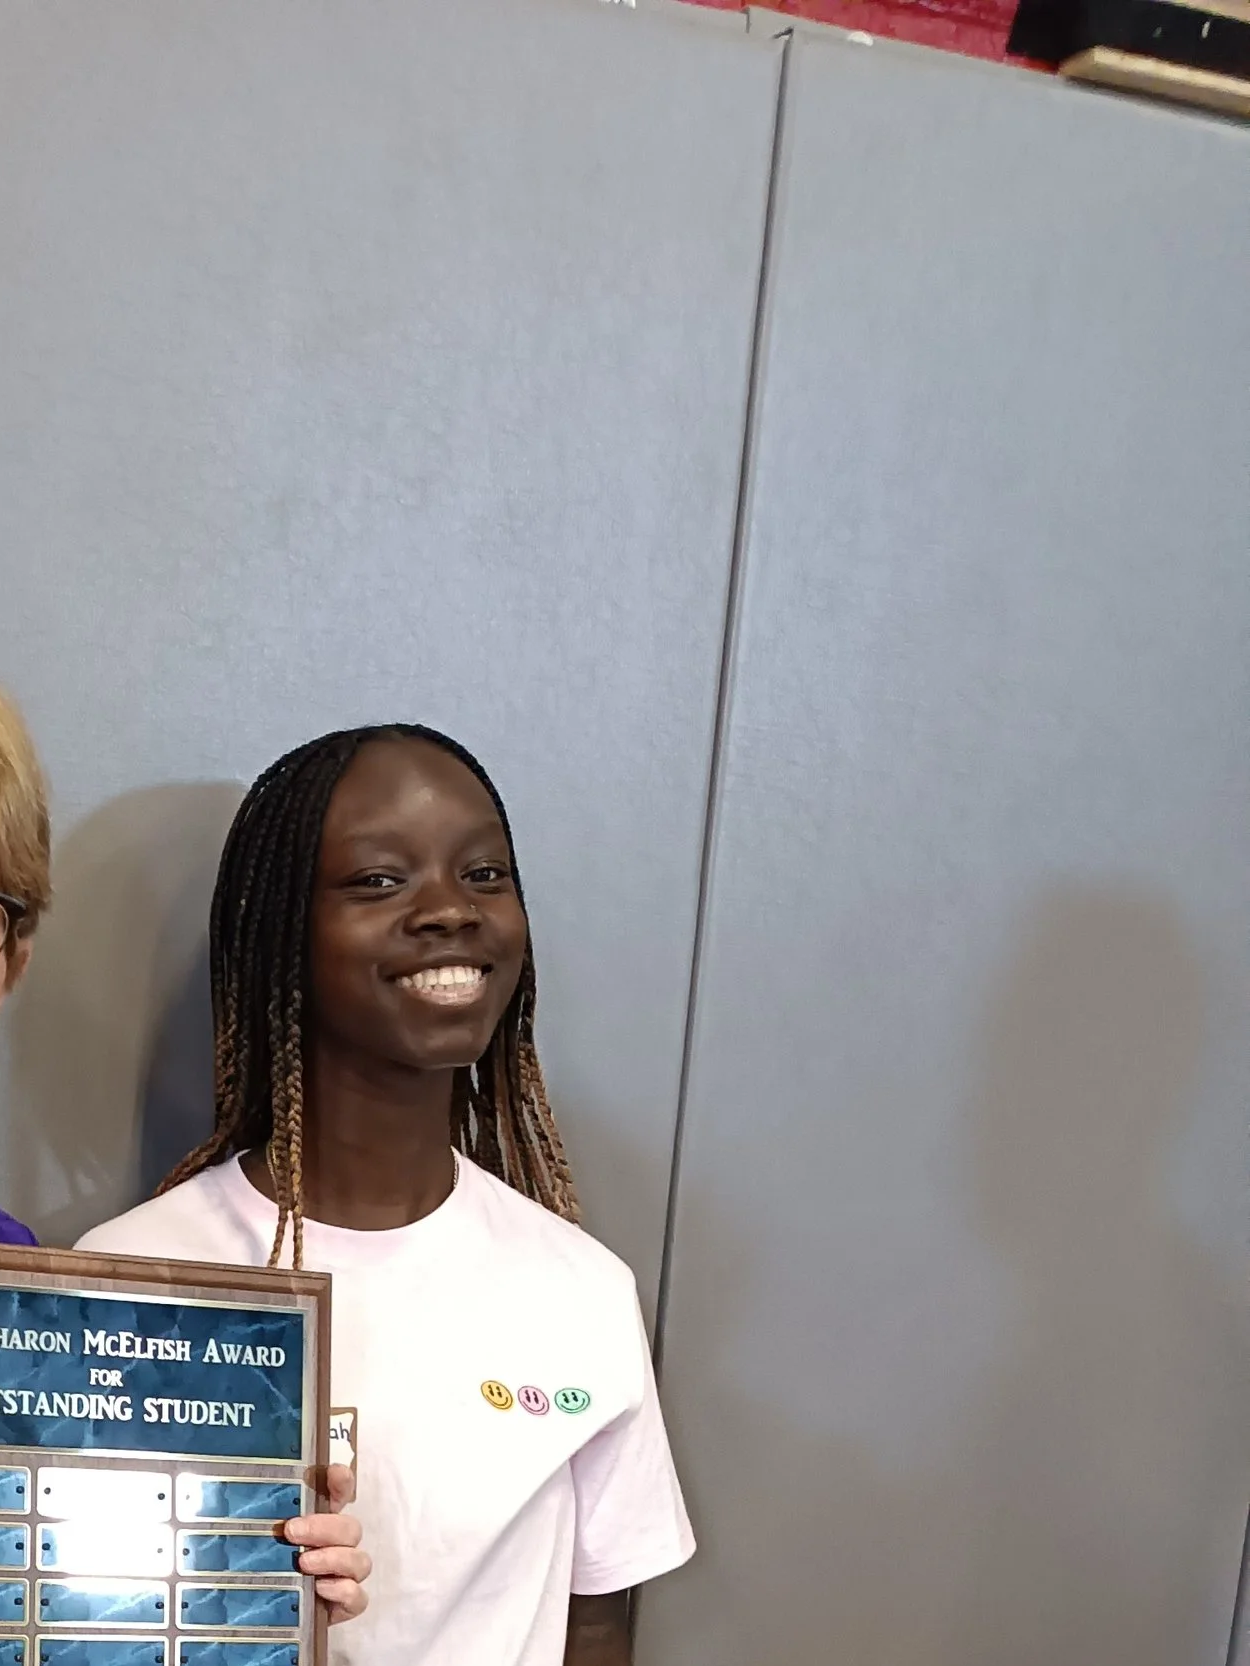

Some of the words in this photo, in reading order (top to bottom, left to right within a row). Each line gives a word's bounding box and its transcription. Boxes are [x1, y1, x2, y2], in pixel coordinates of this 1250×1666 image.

[203, 1336, 286, 1369] AWARD
[89, 1368, 124, 1387] FOR
[142, 1397, 255, 1428] STUDENT
[329, 1421, 351, 1443] ah
